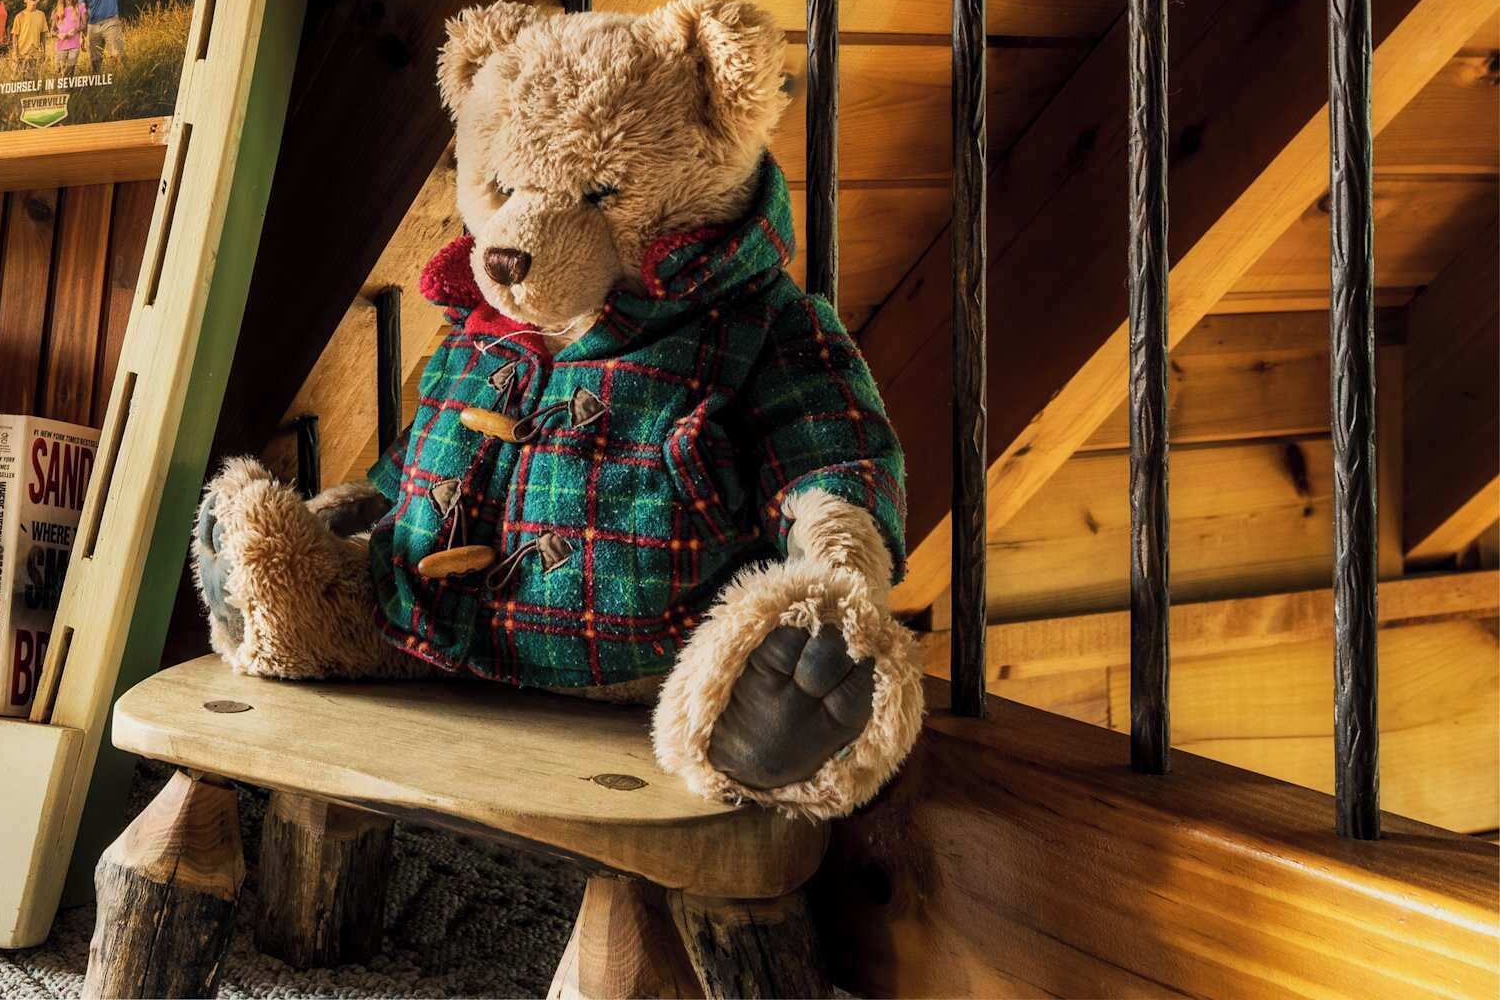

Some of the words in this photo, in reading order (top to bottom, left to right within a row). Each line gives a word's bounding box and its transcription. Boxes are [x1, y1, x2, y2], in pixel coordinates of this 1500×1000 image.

[0, 80, 42, 94] YOURSELF
[45, 79, 54, 90] IN
[57, 73, 113, 89] SEVIERVILLE
[23, 96, 67, 108] SEVIERVILLE
[40, 430, 52, 439] NEW
[53, 432, 66, 441] YORK
[66, 435, 80, 444] TIMES
[32, 521, 70, 546] WHERE
